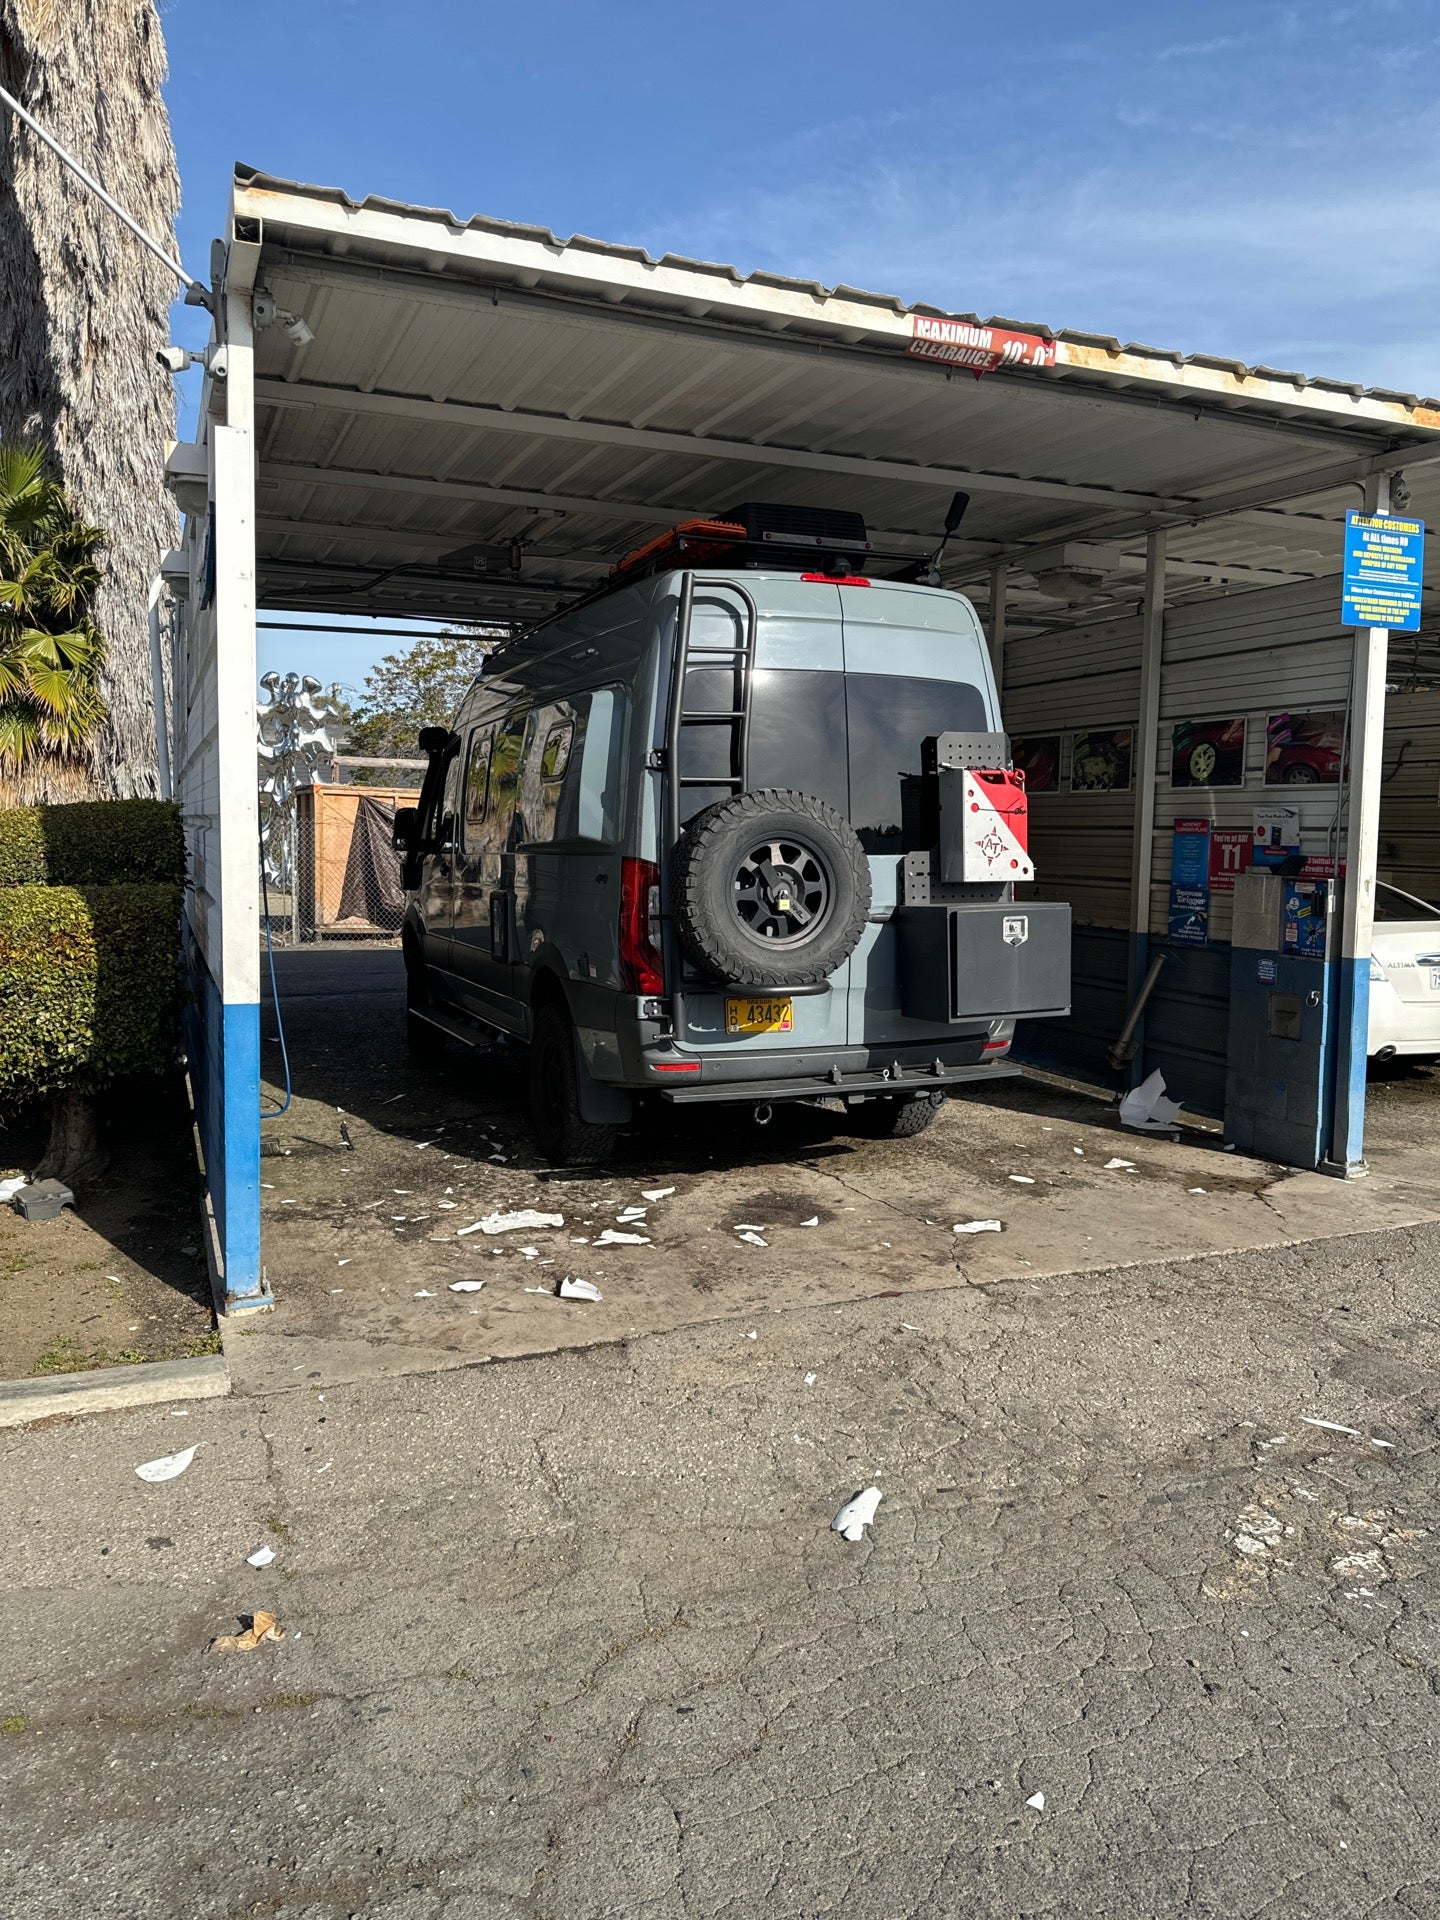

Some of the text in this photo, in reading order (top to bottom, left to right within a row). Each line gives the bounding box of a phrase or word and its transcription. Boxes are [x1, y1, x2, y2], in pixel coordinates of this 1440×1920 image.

[917, 319, 993, 349] MAXIMUM
[909, 339, 995, 367] CLEARANCE
[1350, 515, 1420, 534] ATTENTION CUSTOMERS
[1370, 532, 1380, 544] ALL
[1381, 534, 1399, 546] times
[1400, 537, 1408, 546] NO
[1214, 834, 1230, 842] You're
[1222, 844, 1240, 870] T1
[748, 1004, 789, 1024] 43432
